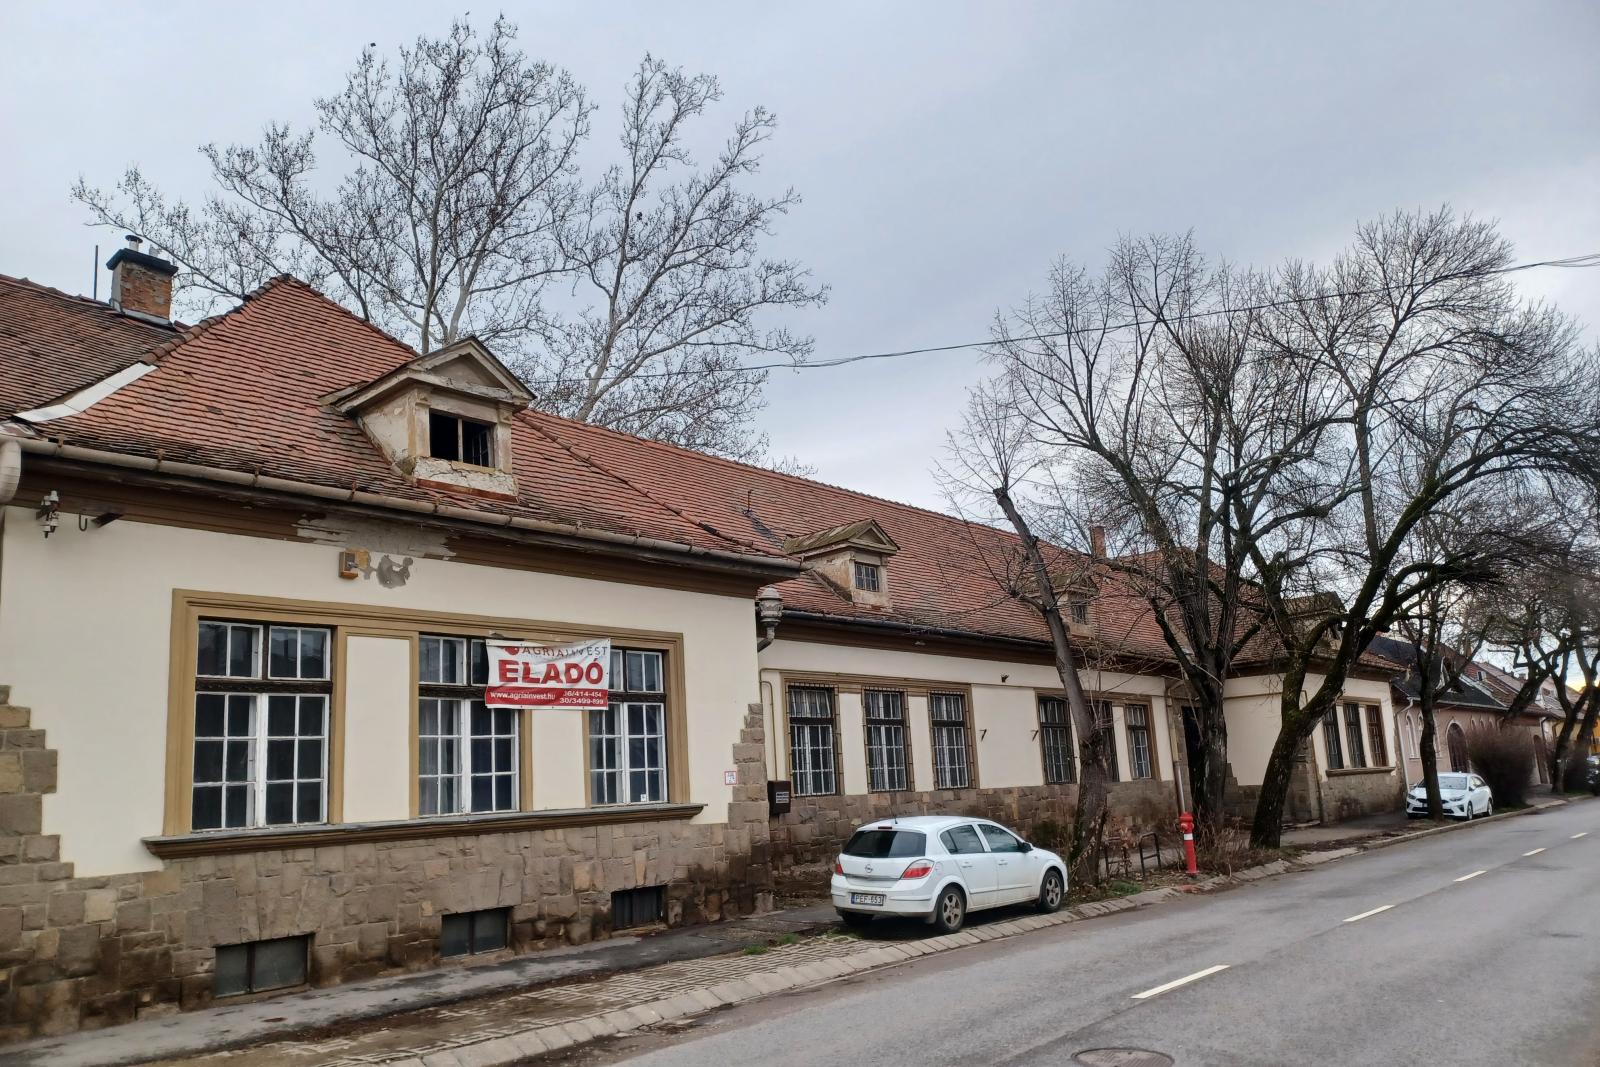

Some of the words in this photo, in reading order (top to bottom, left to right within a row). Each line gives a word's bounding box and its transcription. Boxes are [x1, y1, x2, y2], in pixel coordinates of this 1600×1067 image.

[522, 646, 608, 657] AGRIAINVEST
[498, 657, 604, 685] ELADÓ
[490, 691, 556, 700] www.agriainvest.hu
